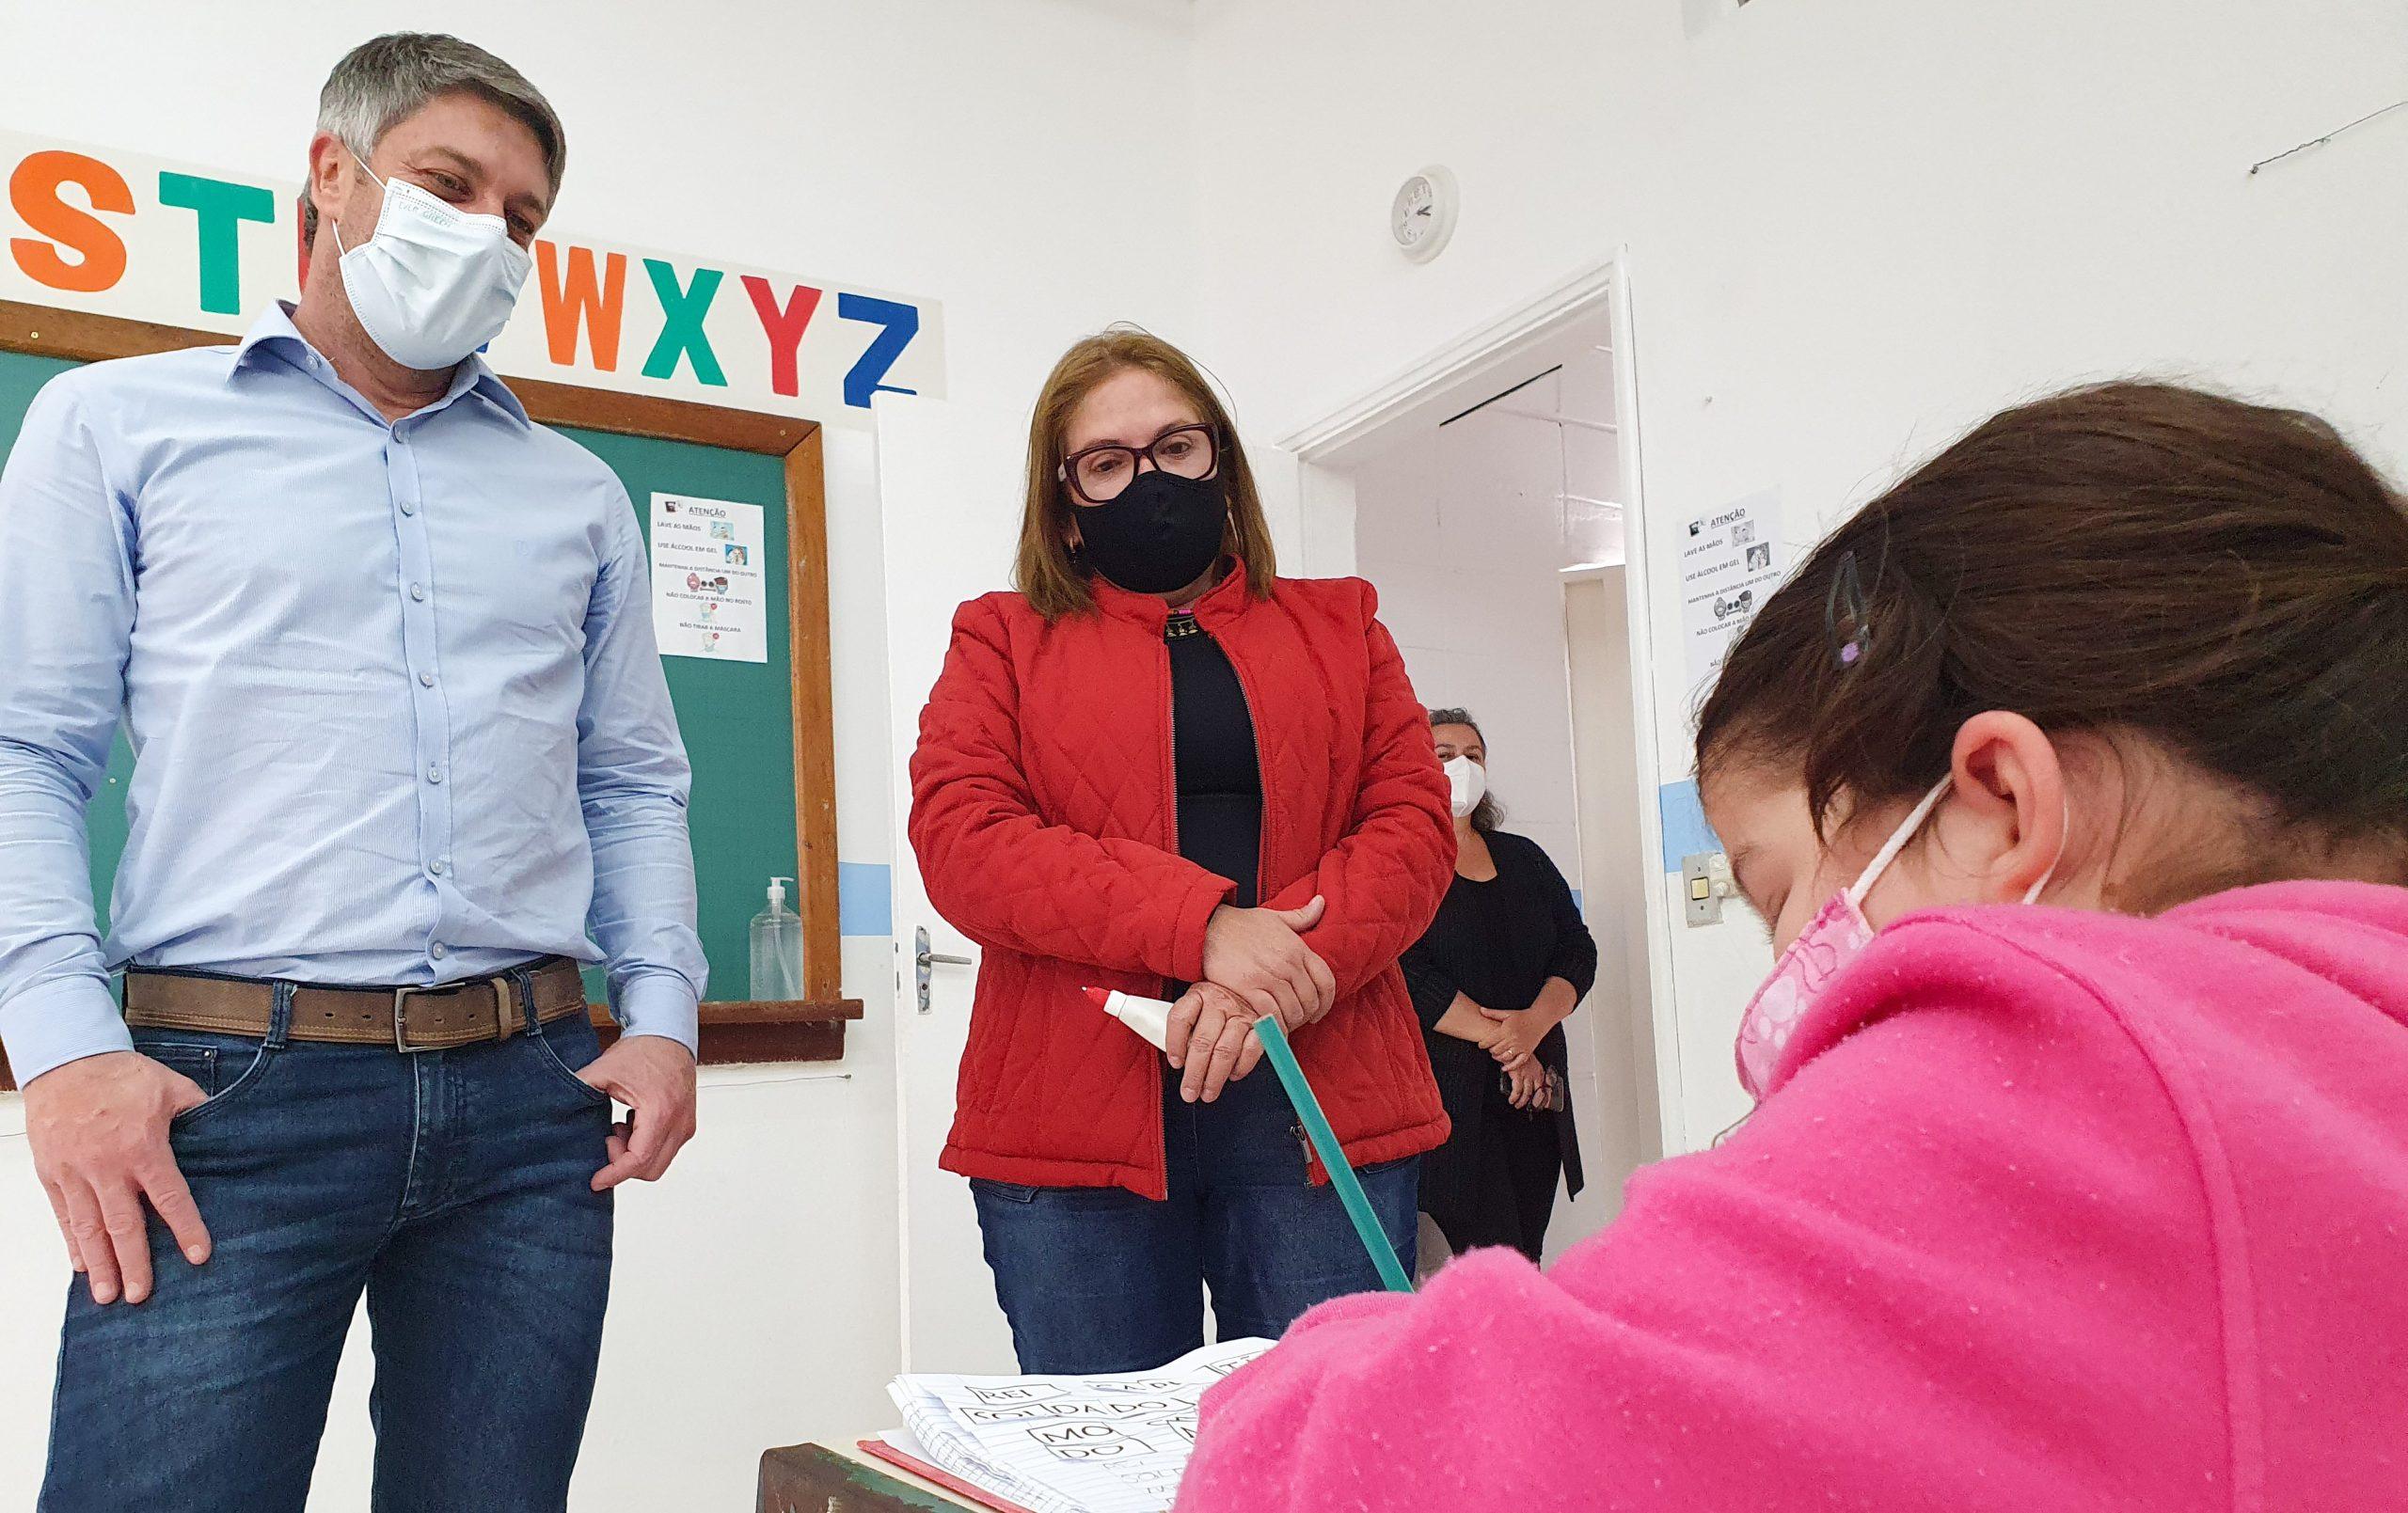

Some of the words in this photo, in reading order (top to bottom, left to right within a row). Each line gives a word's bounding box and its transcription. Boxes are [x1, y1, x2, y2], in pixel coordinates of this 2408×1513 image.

[10, 150, 135, 292] S
[159, 171, 276, 315] T
[535, 240, 626, 372] W
[642, 259, 728, 386] X
[740, 276, 822, 397] Y
[838, 292, 919, 409] Z
[689, 506, 726, 518] ATENÇÃO
[1711, 508, 1746, 528] ATENÇÃO
[1684, 548, 1697, 558] LAVE
[1706, 538, 1723, 550] MÃOS
[1686, 573, 1696, 582] USE
[1719, 561, 1728, 571] EM
[1729, 559, 1740, 567] GEL
[1763, 571, 1781, 581] OUTRO
[1696, 627, 1707, 637] NÃO
[1708, 621, 1731, 634] COLOCAR
[978, 1389, 1033, 1400] REI
